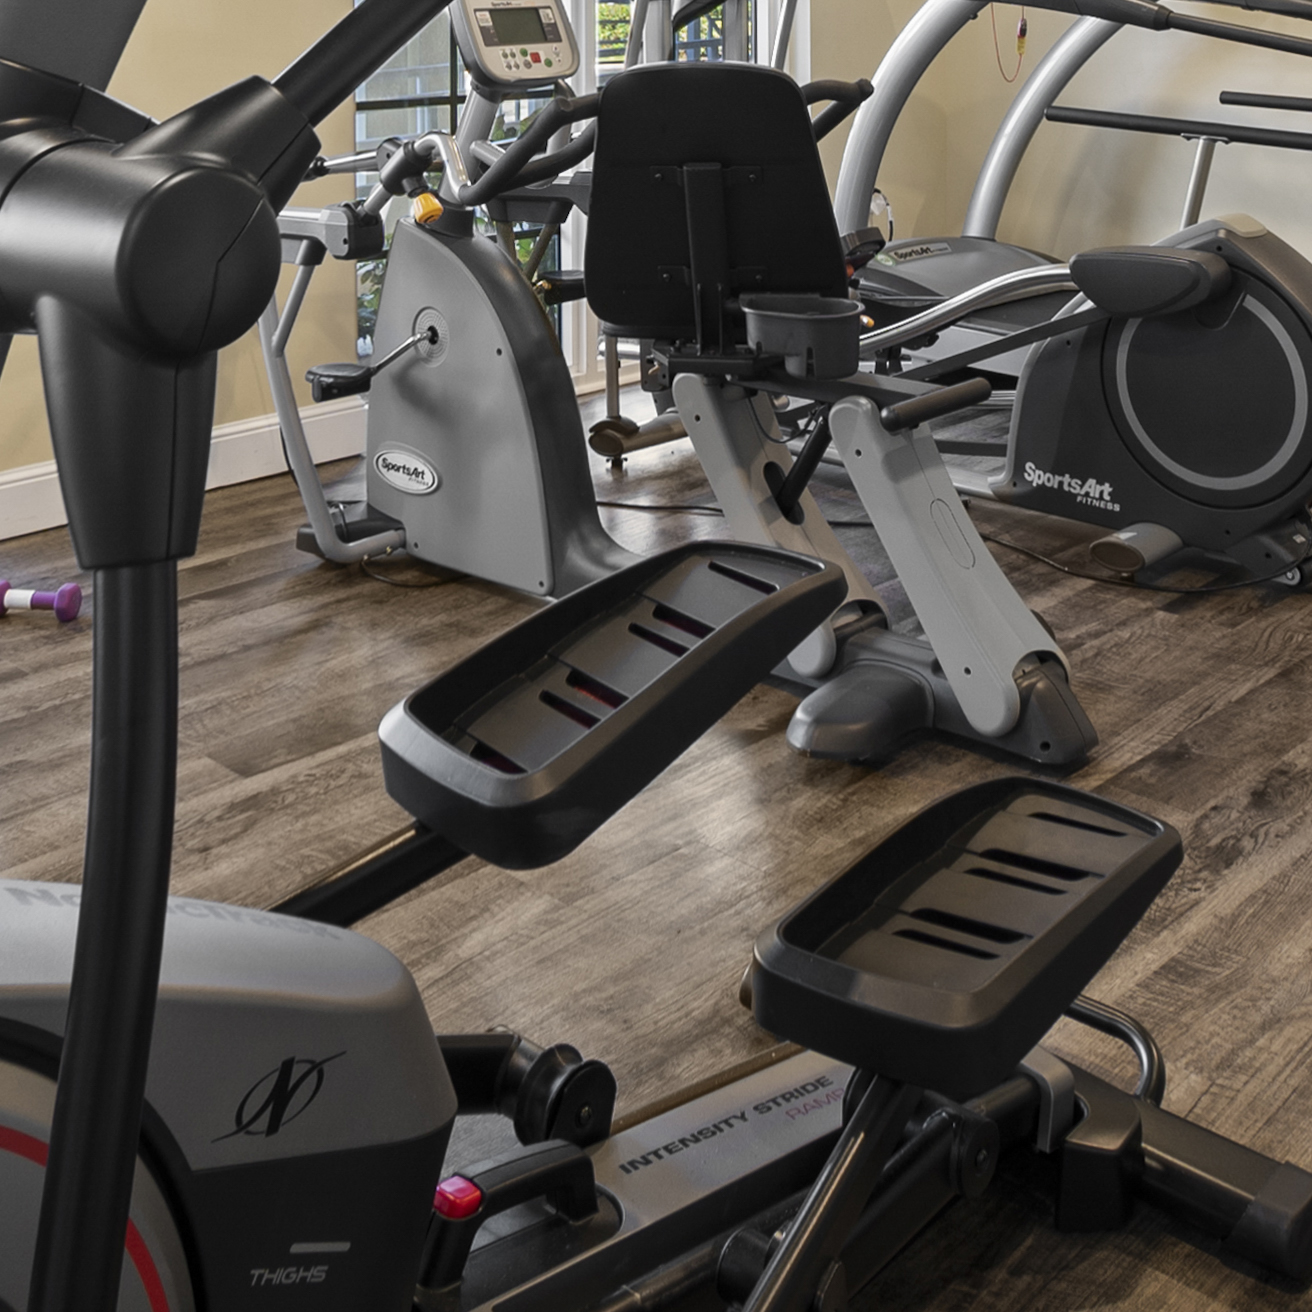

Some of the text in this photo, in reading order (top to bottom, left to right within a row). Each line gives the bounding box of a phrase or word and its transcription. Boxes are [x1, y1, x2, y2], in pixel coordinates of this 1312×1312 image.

[381, 457, 425, 481] SportsArt
[1024, 461, 1113, 501] SportsArt
[1076, 495, 1121, 512] FITNESS
[785, 1086, 846, 1121] RAMP
[618, 1075, 834, 1175] INTENSITY STRIDE
[250, 1265, 329, 1287] THIGHS
